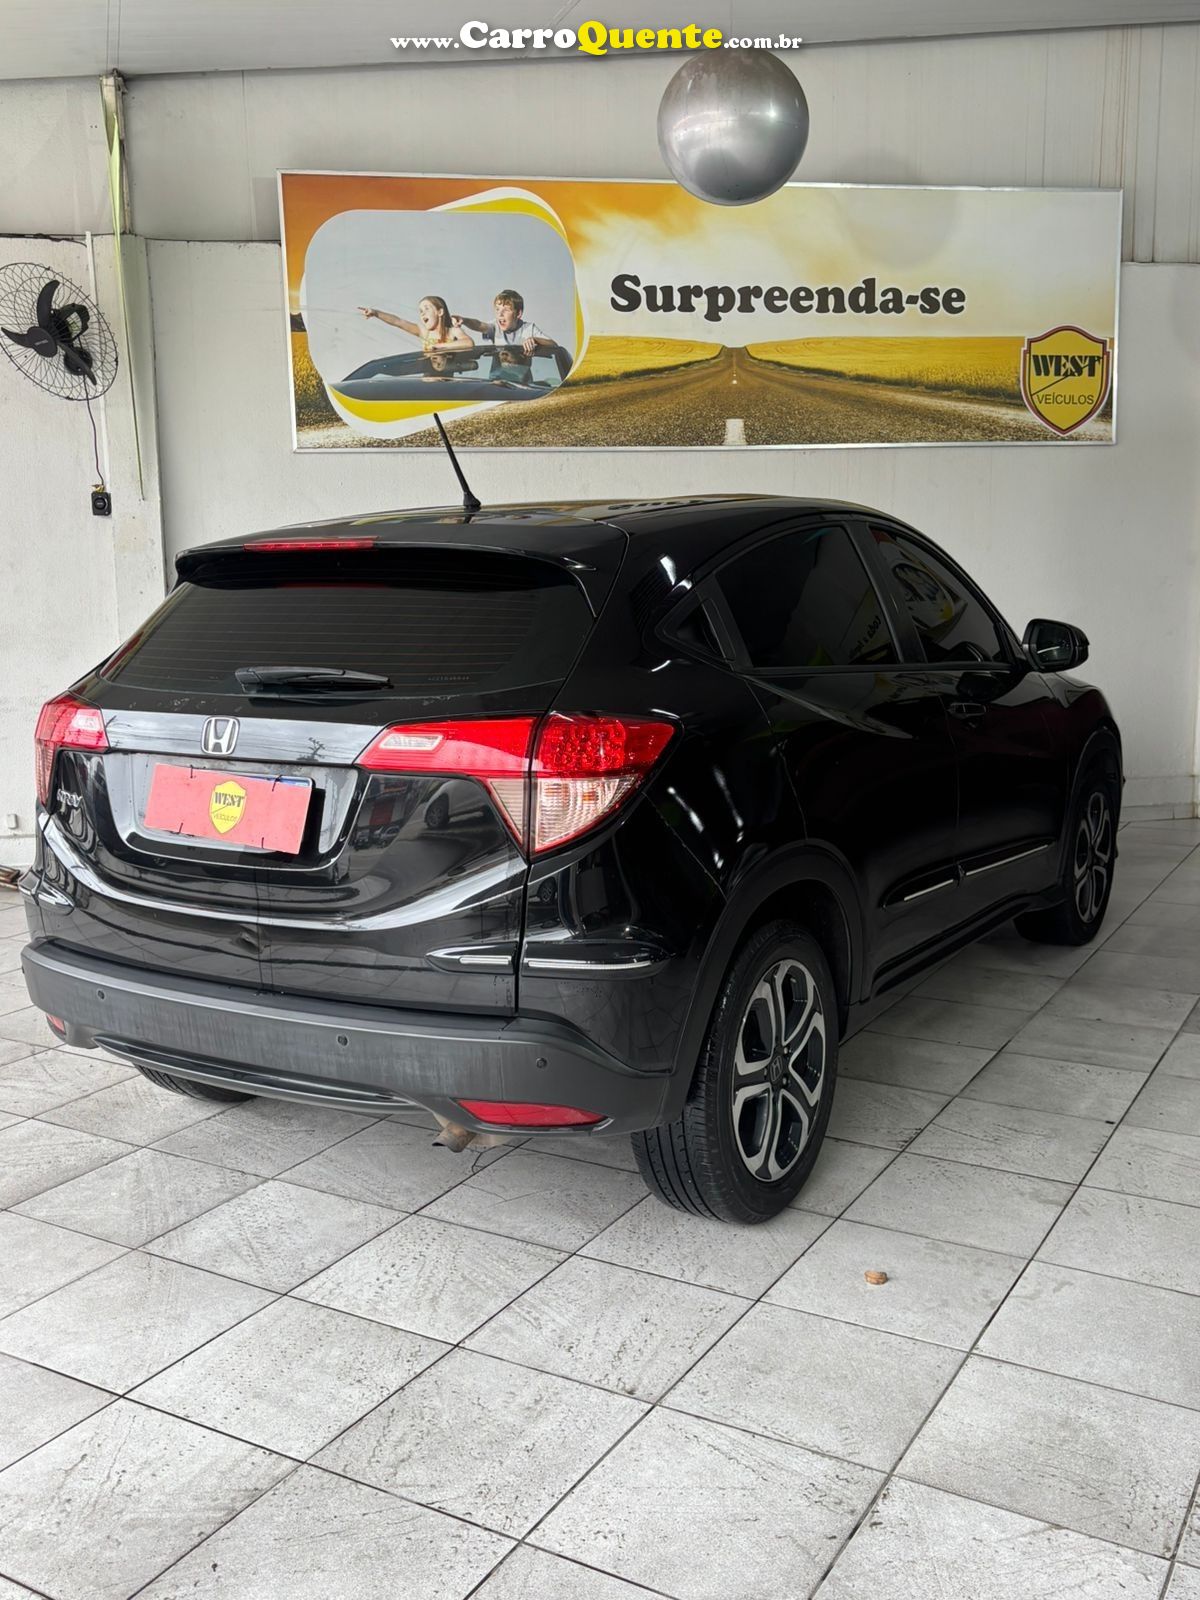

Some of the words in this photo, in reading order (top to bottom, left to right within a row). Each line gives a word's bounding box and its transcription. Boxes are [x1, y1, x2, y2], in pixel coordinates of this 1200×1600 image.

[610, 273, 967, 323] Surpreenda-se
[1032, 354, 1102, 377] WEST
[1036, 391, 1095, 405] VEÍCULOS
[214, 791, 245, 808] WEST
